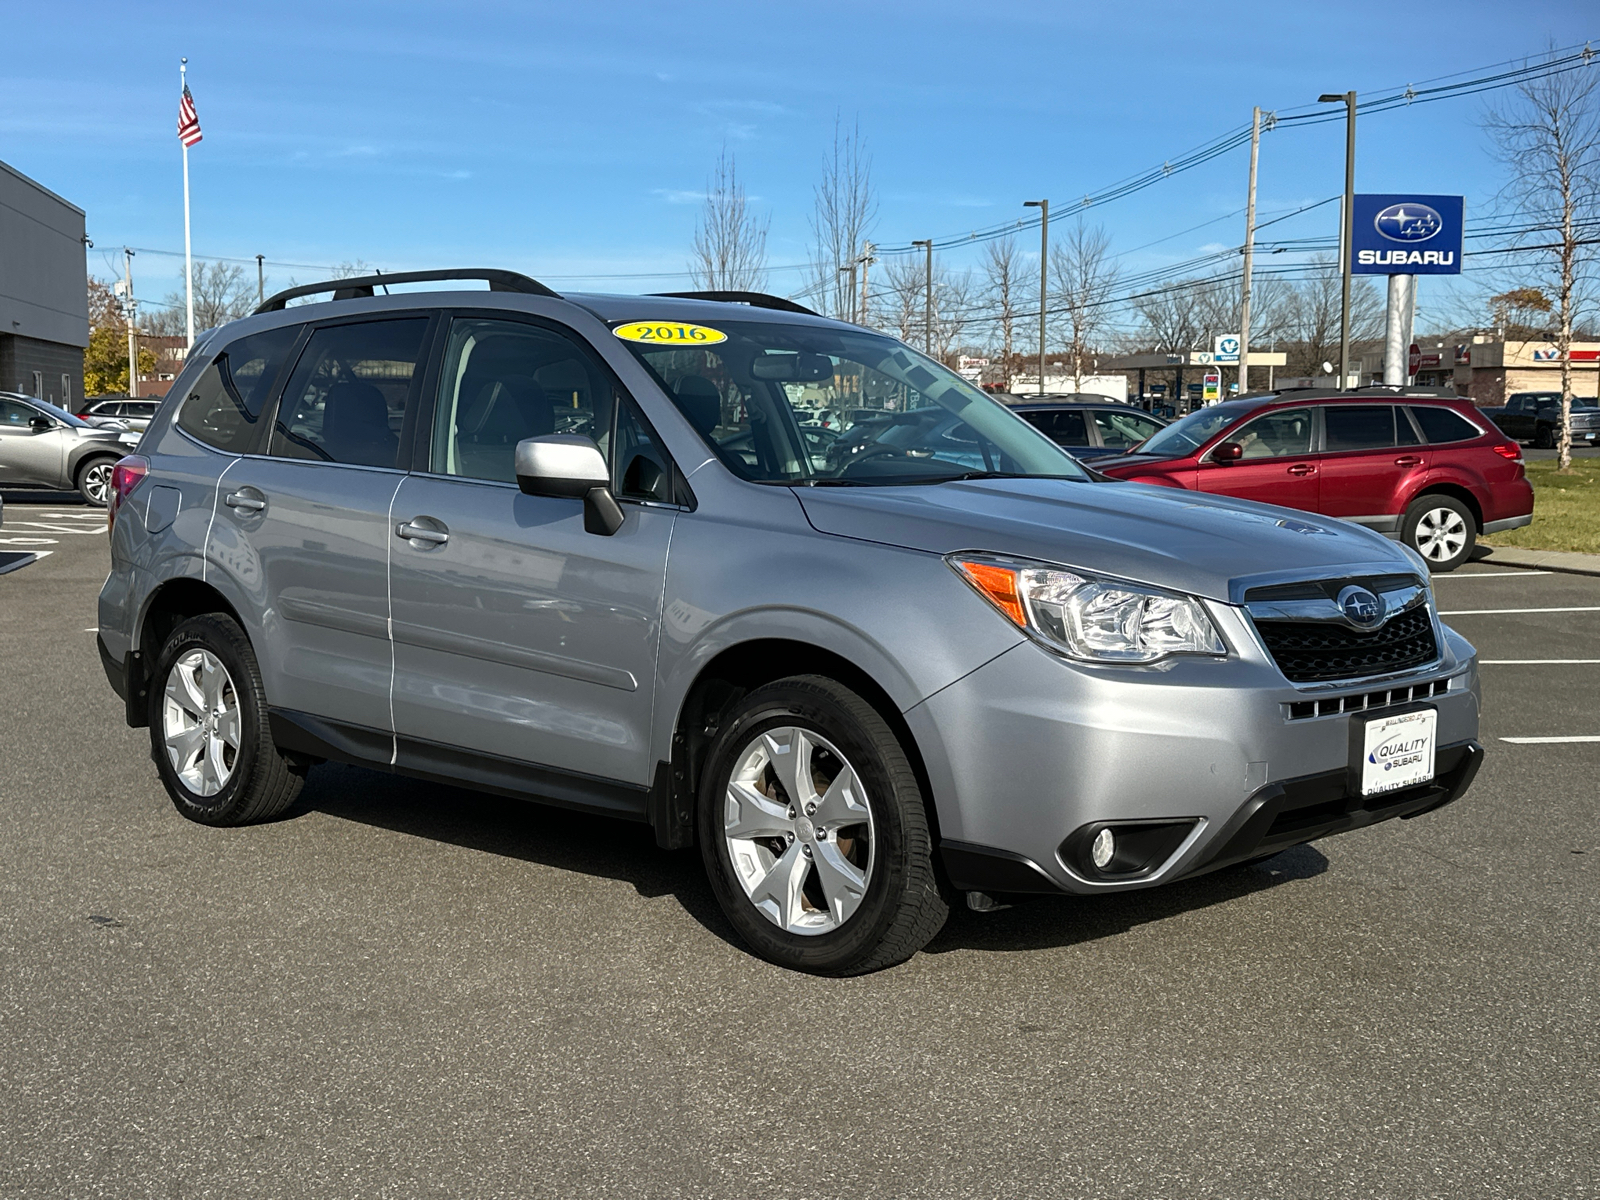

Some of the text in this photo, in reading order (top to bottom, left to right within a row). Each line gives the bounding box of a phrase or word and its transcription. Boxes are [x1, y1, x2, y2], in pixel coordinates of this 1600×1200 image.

[1358, 250, 1454, 266] SUBARU
[636, 326, 707, 340] 2016
[1379, 737, 1428, 757] QUALITY
[1392, 754, 1423, 768] SUBARU
[1367, 774, 1433, 795] QUALITY SUBARU
